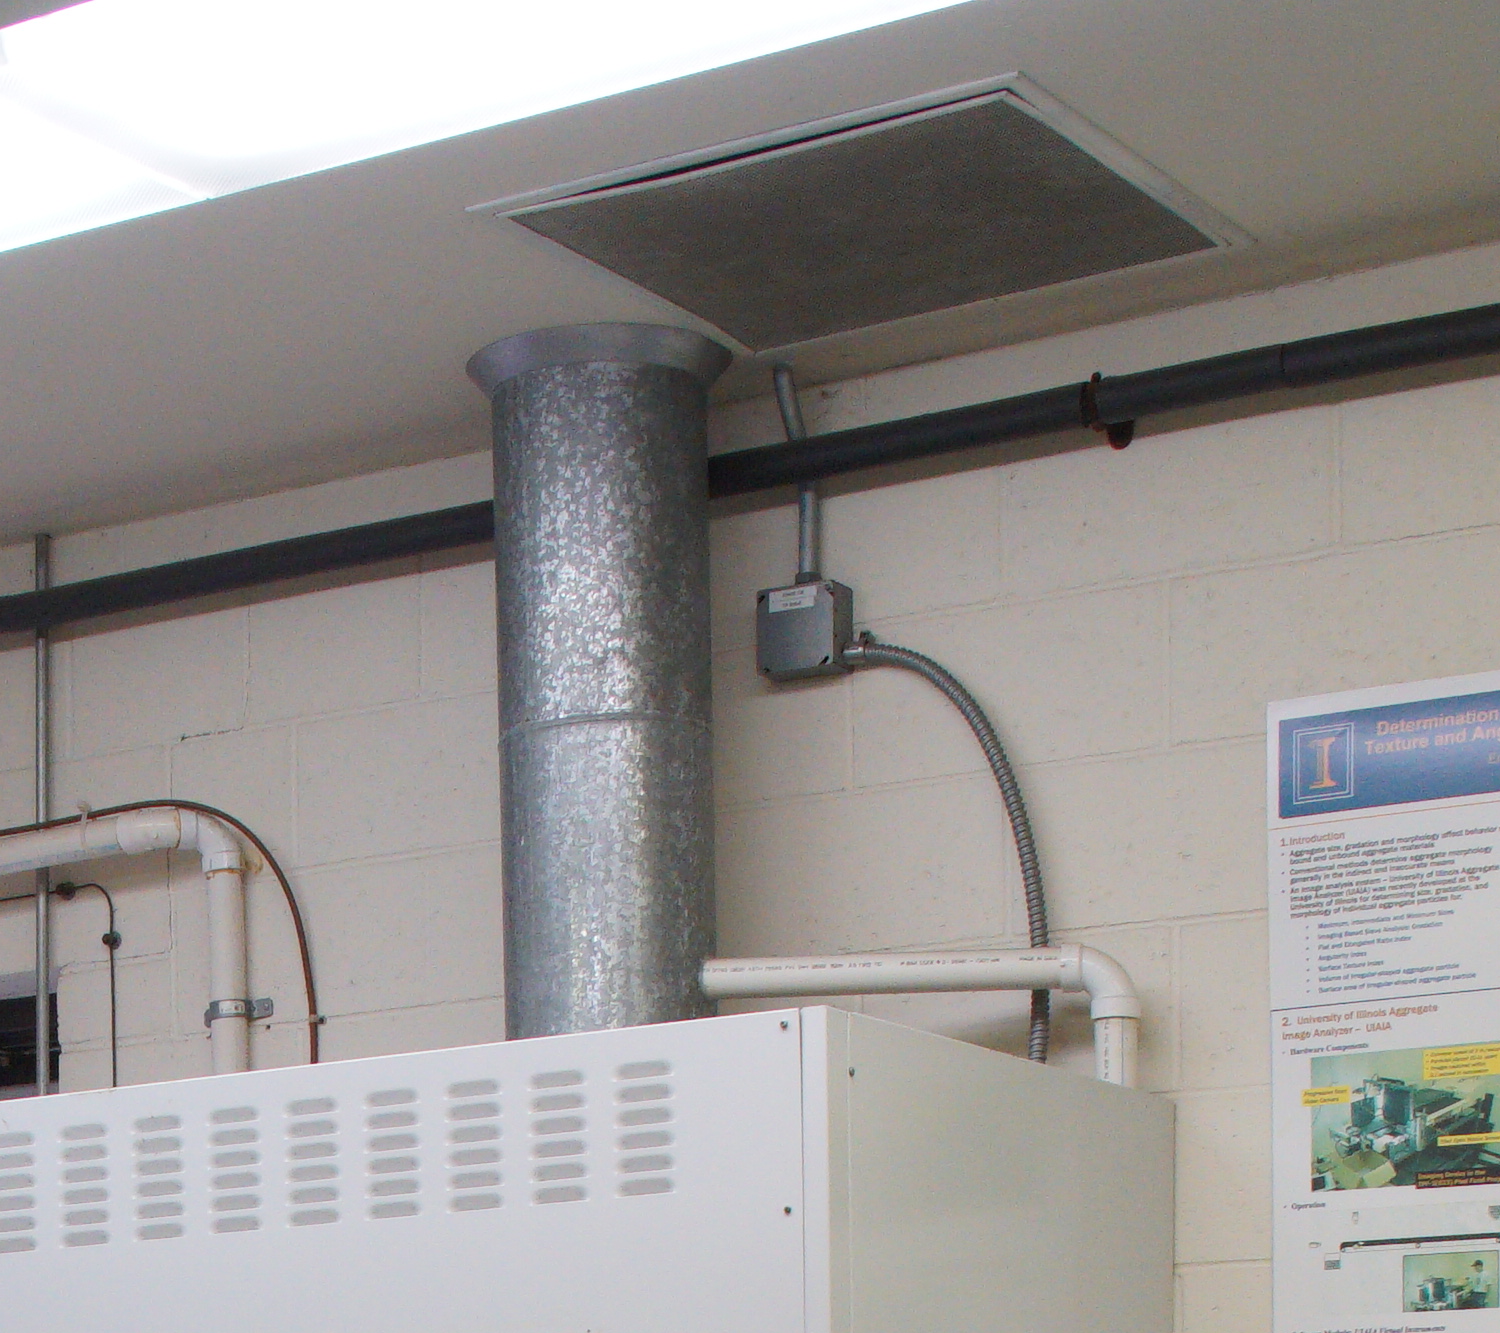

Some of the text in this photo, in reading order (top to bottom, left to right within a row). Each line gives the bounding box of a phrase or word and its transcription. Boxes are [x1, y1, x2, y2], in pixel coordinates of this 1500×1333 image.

[1376, 709, 1499, 736] Determination
[1364, 731, 1429, 755] Texture
[1434, 726, 1467, 746] and
[1289, 831, 1345, 846] Introduction
[1297, 1013, 1342, 1026] University
[1345, 1011, 1354, 1020] of
[1356, 1008, 1386, 1019] Illinois
[1389, 1004, 1438, 1018] Aggregate
[1313, 1026, 1353, 1039] Analyzer
[1290, 1042, 1369, 1055] Hardware Components
[1291, 1201, 1326, 1211] Operation
